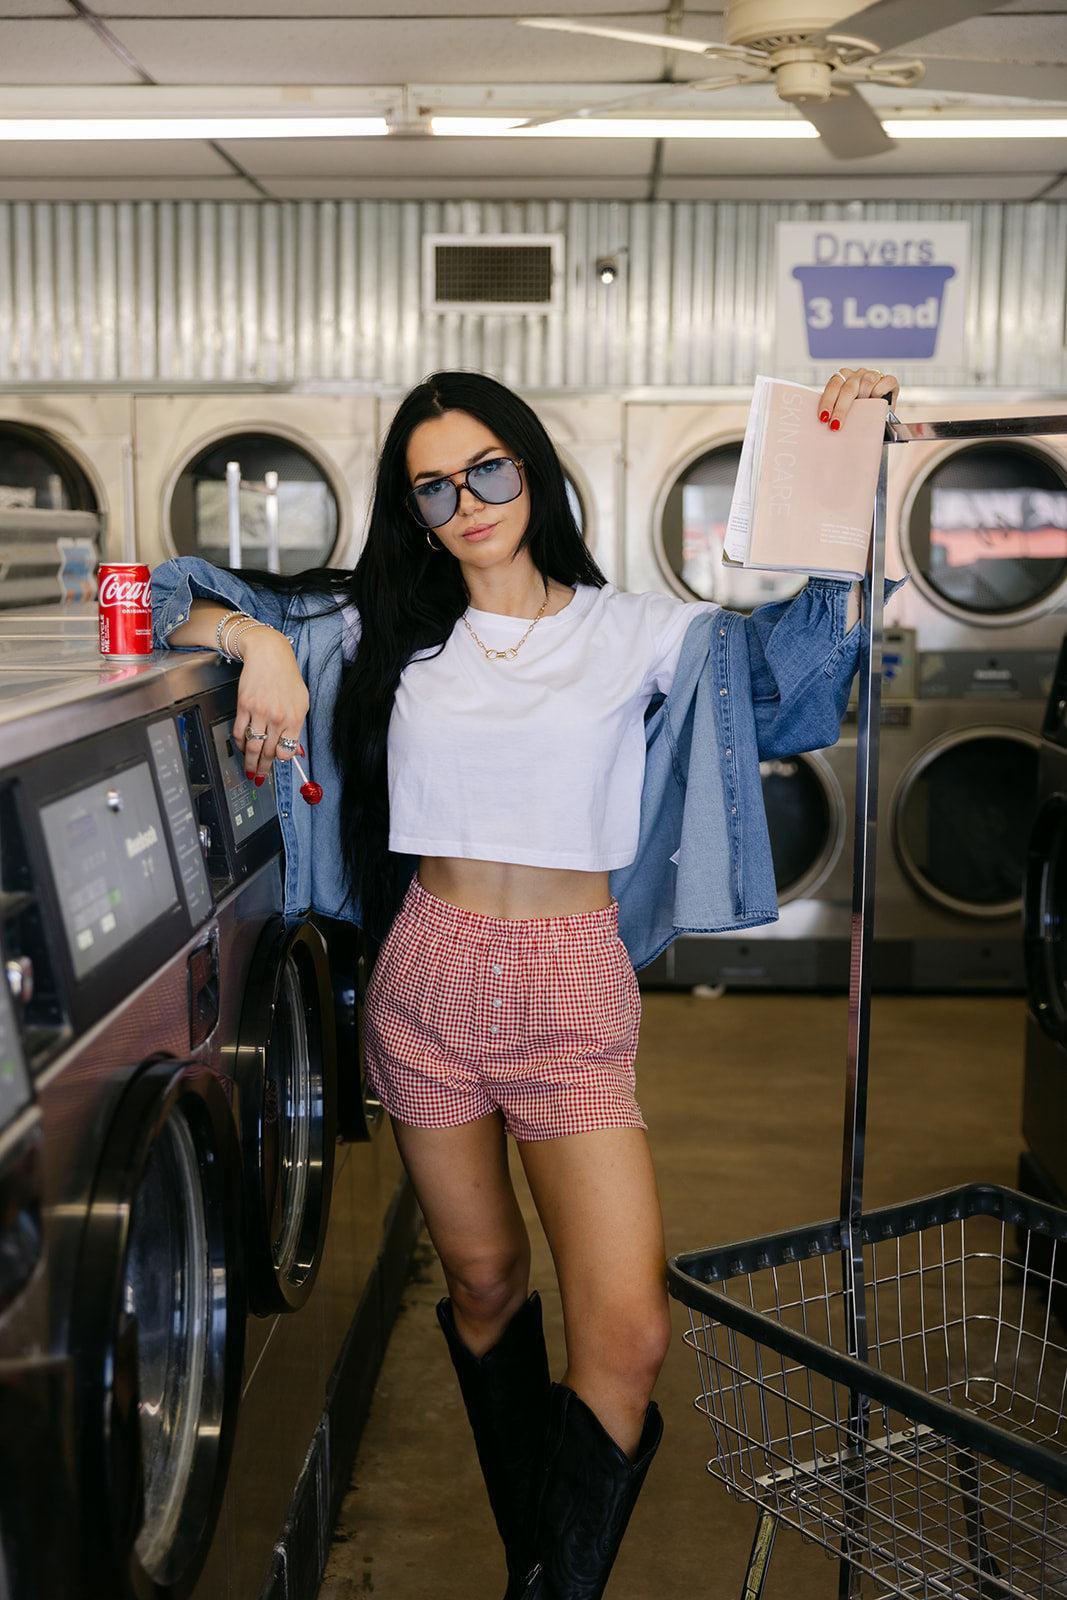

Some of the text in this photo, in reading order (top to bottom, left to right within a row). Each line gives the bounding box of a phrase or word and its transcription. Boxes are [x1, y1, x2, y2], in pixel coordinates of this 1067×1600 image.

[814, 232, 936, 266] Dryers
[807, 297, 938, 329] 3 Load
[768, 391, 802, 520] SKIN CARE
